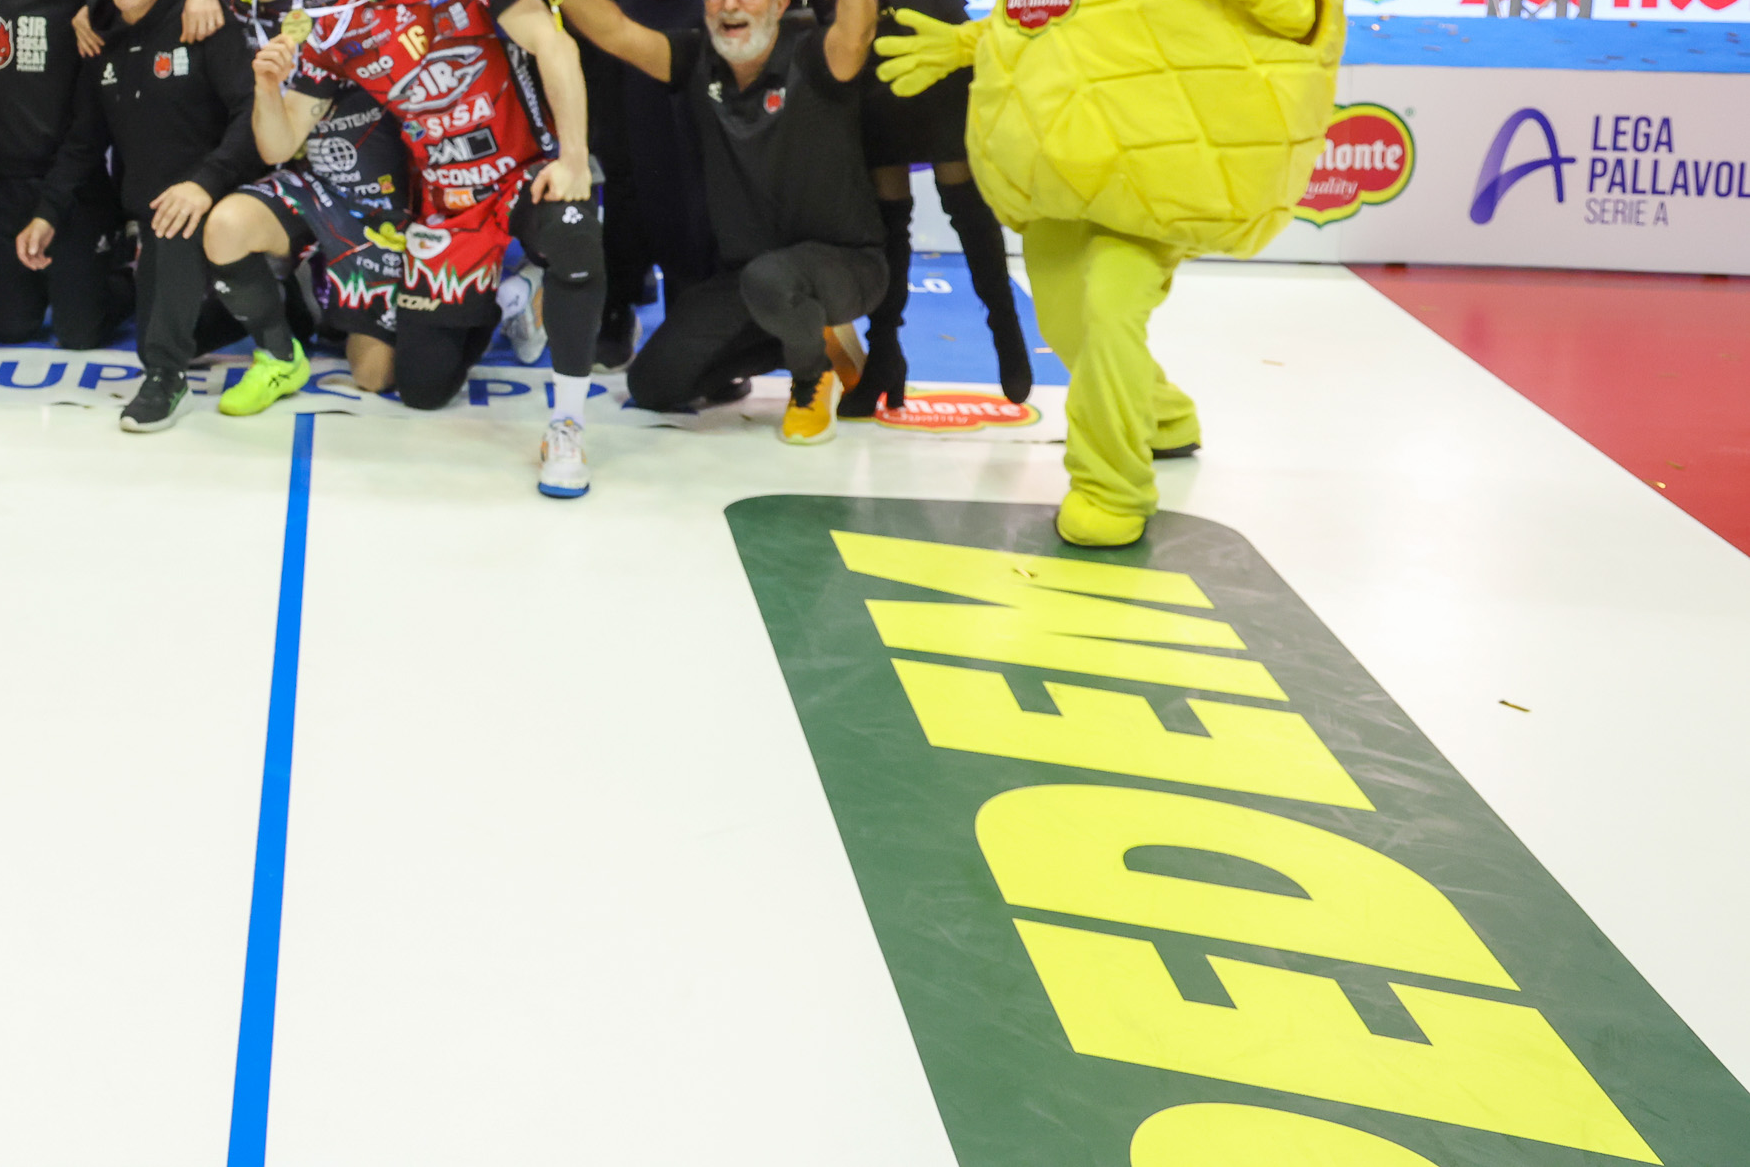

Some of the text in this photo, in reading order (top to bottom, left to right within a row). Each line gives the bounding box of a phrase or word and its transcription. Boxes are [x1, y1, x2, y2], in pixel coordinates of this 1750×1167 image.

[17, 16, 47, 37] SIR
[398, 25, 429, 62] 16
[1592, 115, 1674, 154] LEGA
[1584, 199, 1670, 226] SERIE A
